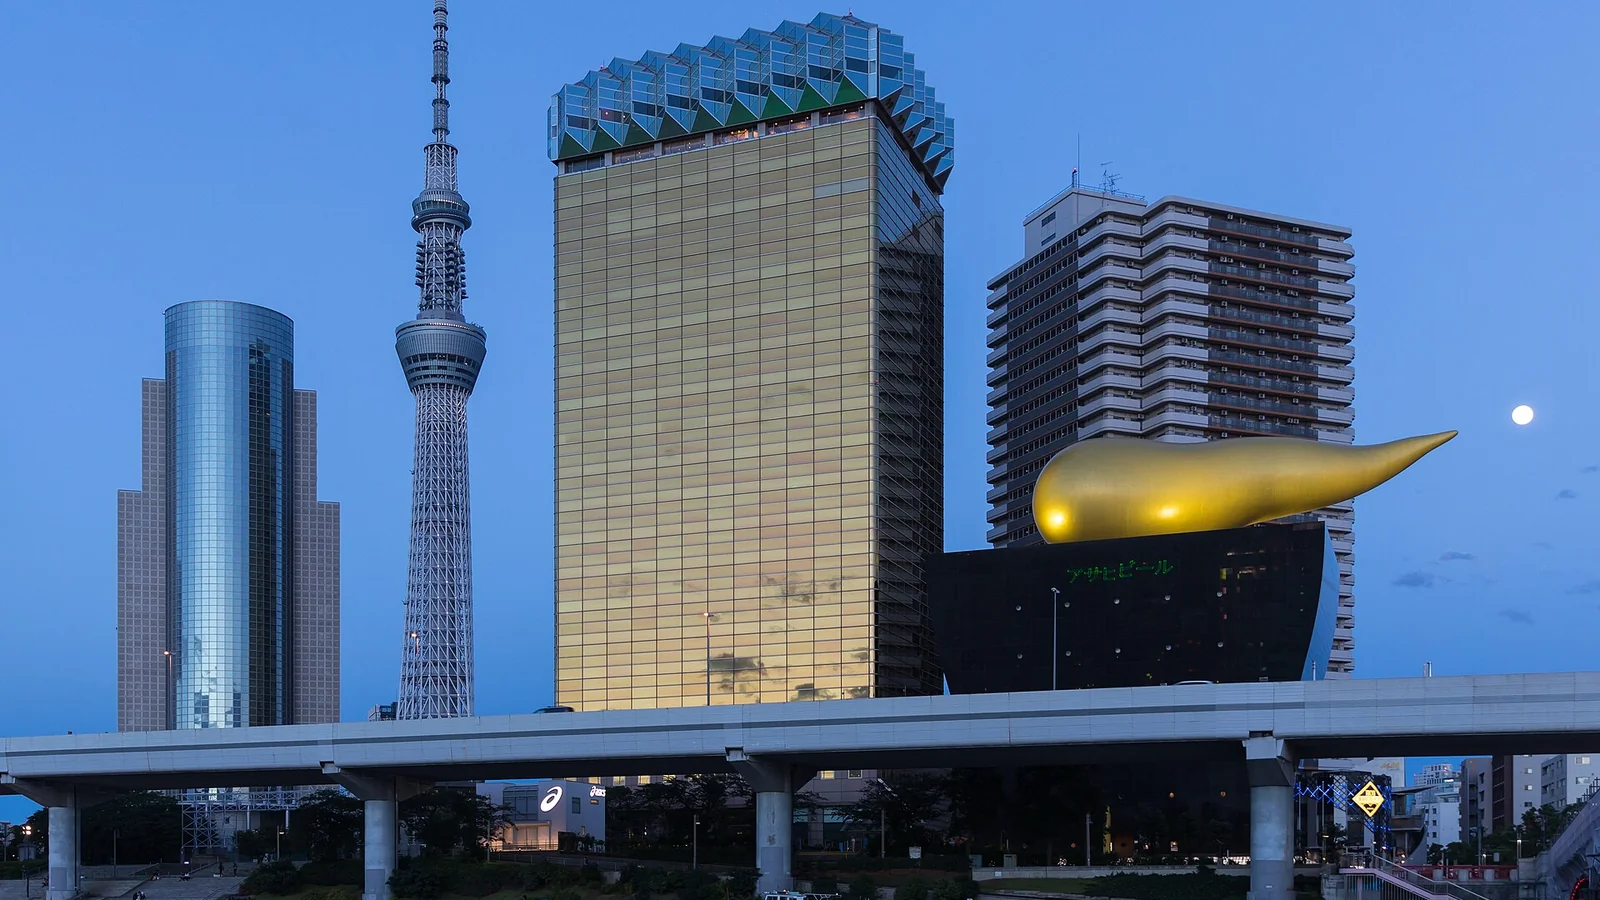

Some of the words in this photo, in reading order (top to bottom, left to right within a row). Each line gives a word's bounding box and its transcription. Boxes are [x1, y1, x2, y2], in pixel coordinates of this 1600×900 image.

[1066, 559, 1174, 584] アサヒビール
